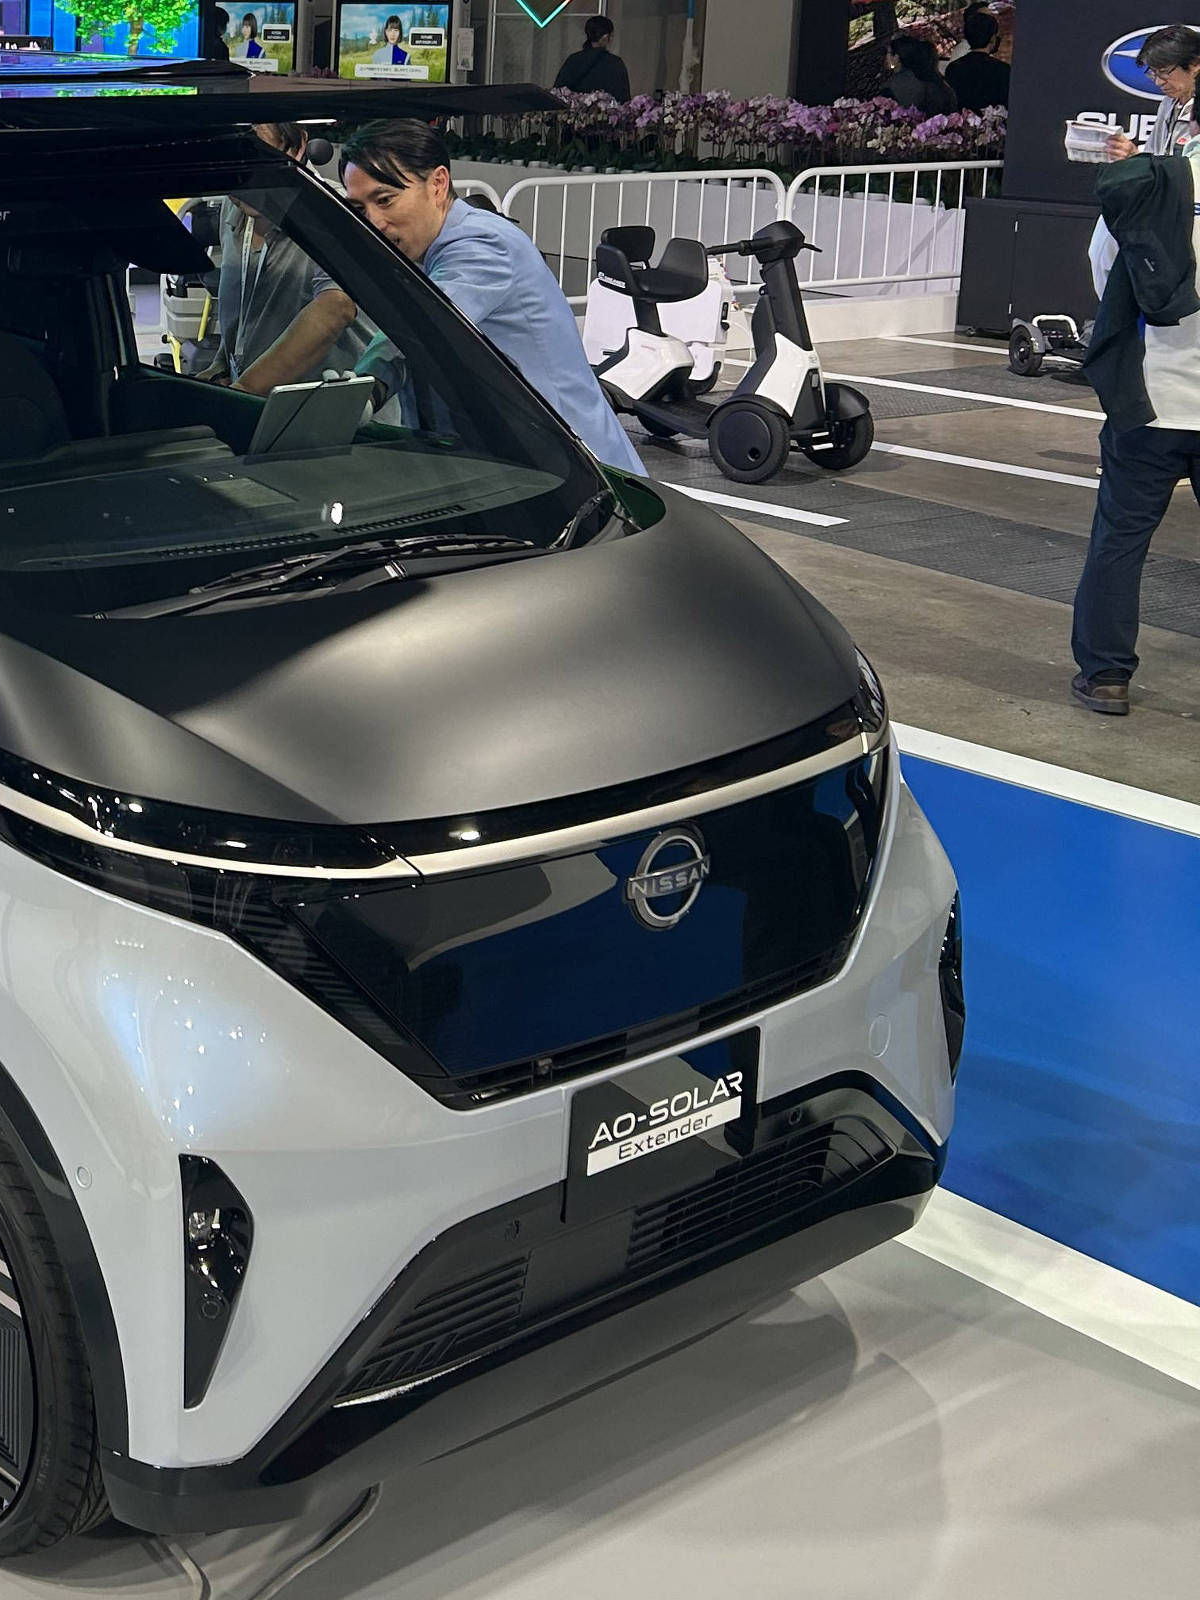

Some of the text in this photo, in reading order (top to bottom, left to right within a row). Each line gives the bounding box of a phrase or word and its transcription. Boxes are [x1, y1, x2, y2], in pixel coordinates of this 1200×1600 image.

[631, 860, 711, 896] NISSAN
[588, 1071, 743, 1150] AO-SOLAR
[619, 1113, 713, 1160] Extender
